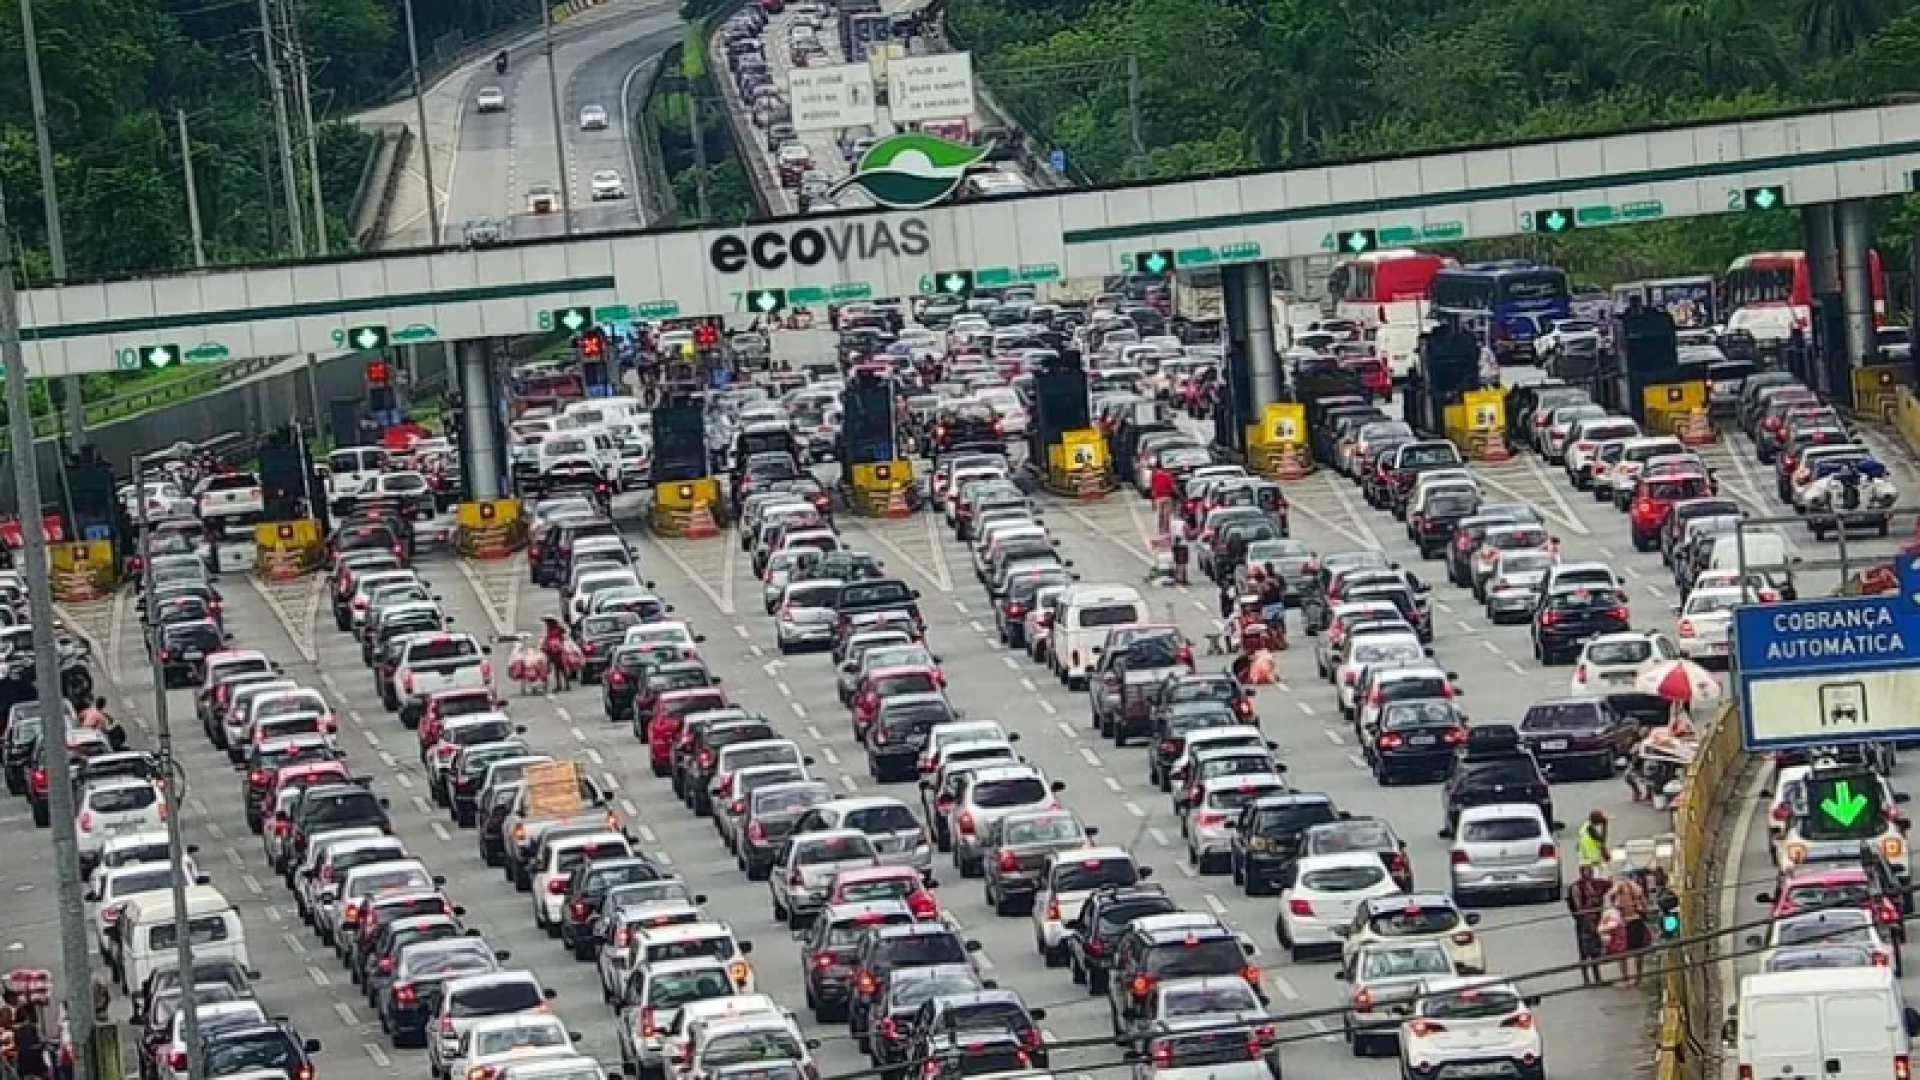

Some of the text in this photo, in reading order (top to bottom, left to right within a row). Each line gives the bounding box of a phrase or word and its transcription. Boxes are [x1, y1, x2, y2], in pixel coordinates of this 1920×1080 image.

[1727, 189, 1742, 209] 2
[1520, 210, 1532, 231] 3
[710, 218, 930, 274] ecoVIAS
[1320, 232, 1335, 253] 4
[1120, 252, 1134, 275] 5
[919, 273, 932, 293] 6
[730, 291, 743, 313] 7
[538, 310, 551, 330] 8
[331, 328, 345, 349] 9
[114, 347, 138, 368] 10
[1773, 606, 1894, 632] COBRANÇA
[1766, 630, 1905, 661] AUTOMÁTICA
